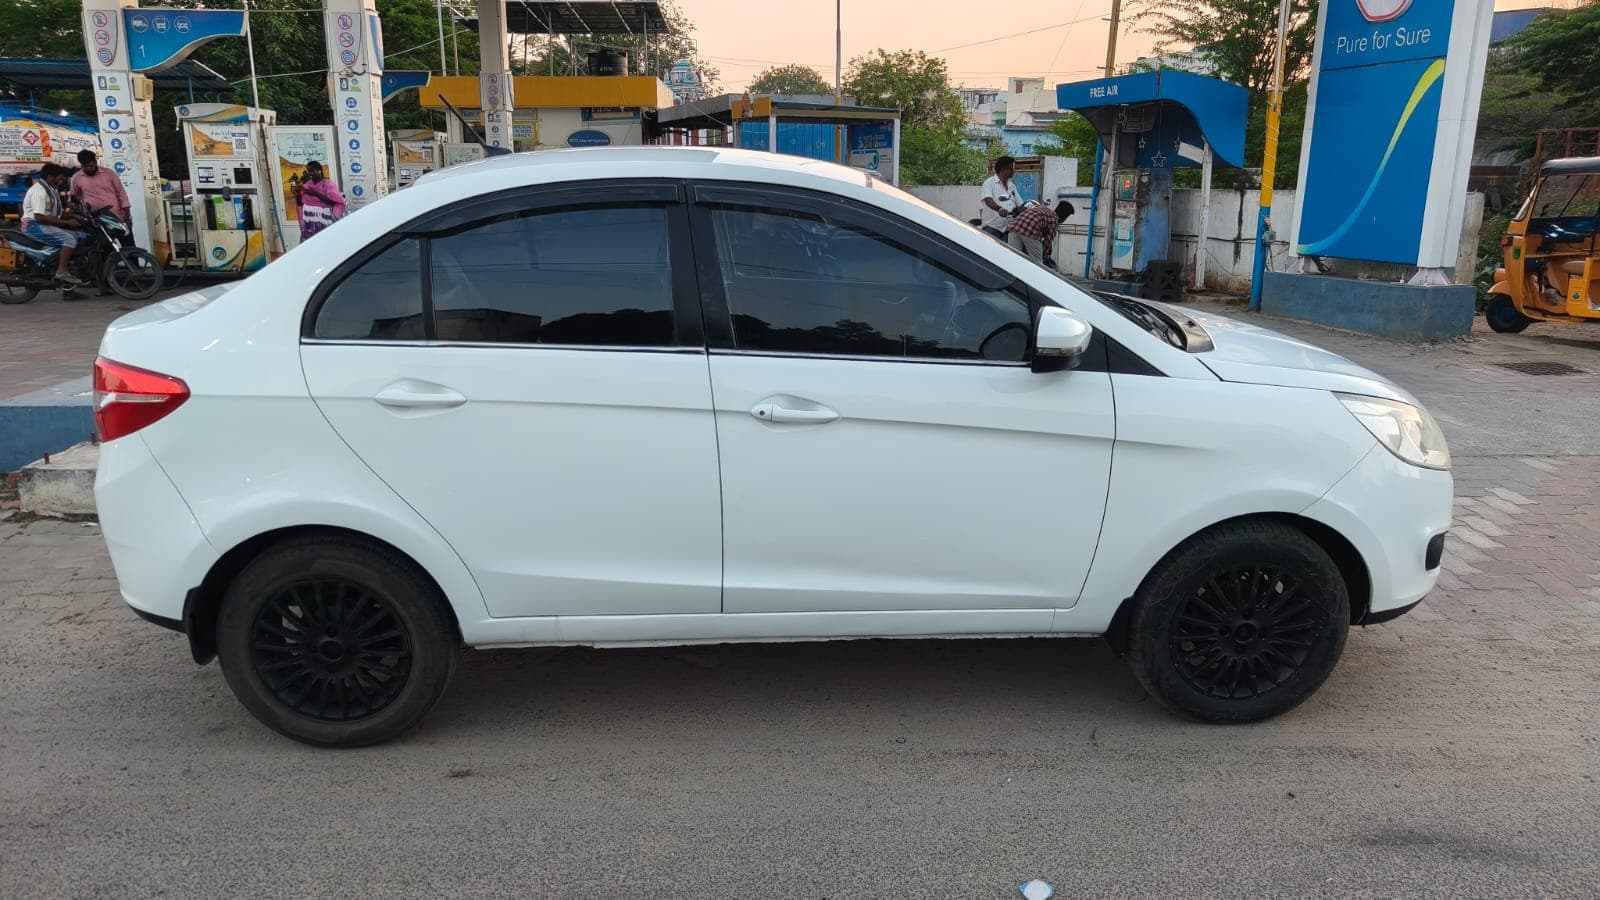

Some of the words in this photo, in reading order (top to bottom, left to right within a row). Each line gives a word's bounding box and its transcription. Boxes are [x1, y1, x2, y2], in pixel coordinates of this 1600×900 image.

[1336, 37, 1368, 54] Pure
[1372, 31, 1391, 49] for
[1395, 27, 1431, 46] Sure
[139, 44, 146, 58] 1
[1089, 86, 1105, 98] FREE
[1107, 85, 1118, 96] AIR
